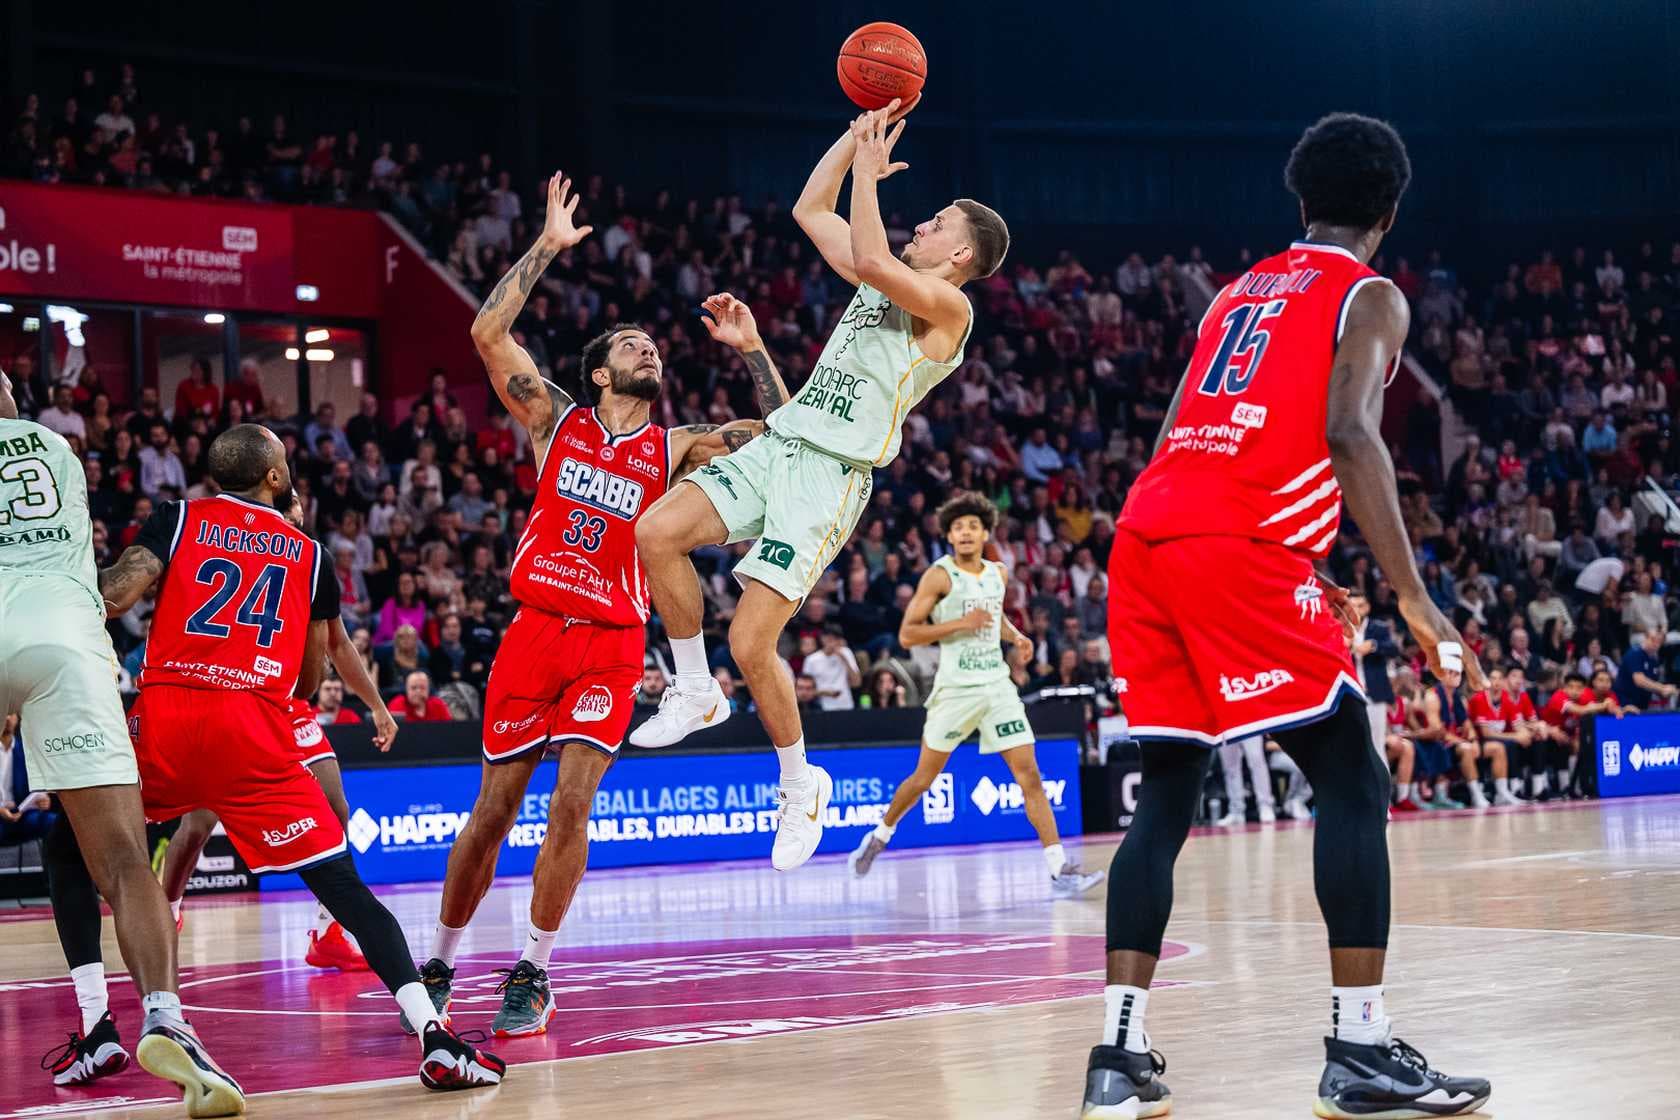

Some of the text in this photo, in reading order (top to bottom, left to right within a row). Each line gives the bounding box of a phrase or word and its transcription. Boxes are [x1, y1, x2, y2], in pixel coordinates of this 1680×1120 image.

[122, 243, 242, 270] SAINT-ÉTIENNE
[1197, 298, 1287, 398] 15
[556, 457, 644, 517] SCABB
[195, 519, 303, 562] JACKSON
[562, 508, 608, 552] 33
[533, 554, 578, 579] Groupe
[579, 568, 614, 594] FAHY
[184, 556, 289, 649] 24
[257, 659, 280, 673] SÉM
[44, 732, 105, 753] SCHOEN
[998, 722, 1024, 736] CIC
[590, 786, 719, 817] BALLAGES
[1000, 779, 1067, 809] HAPY
[380, 811, 471, 846] HAPPY
[508, 815, 653, 848] RECABLES,
[655, 811, 755, 839] DURABLES
[757, 810, 779, 833] ET
